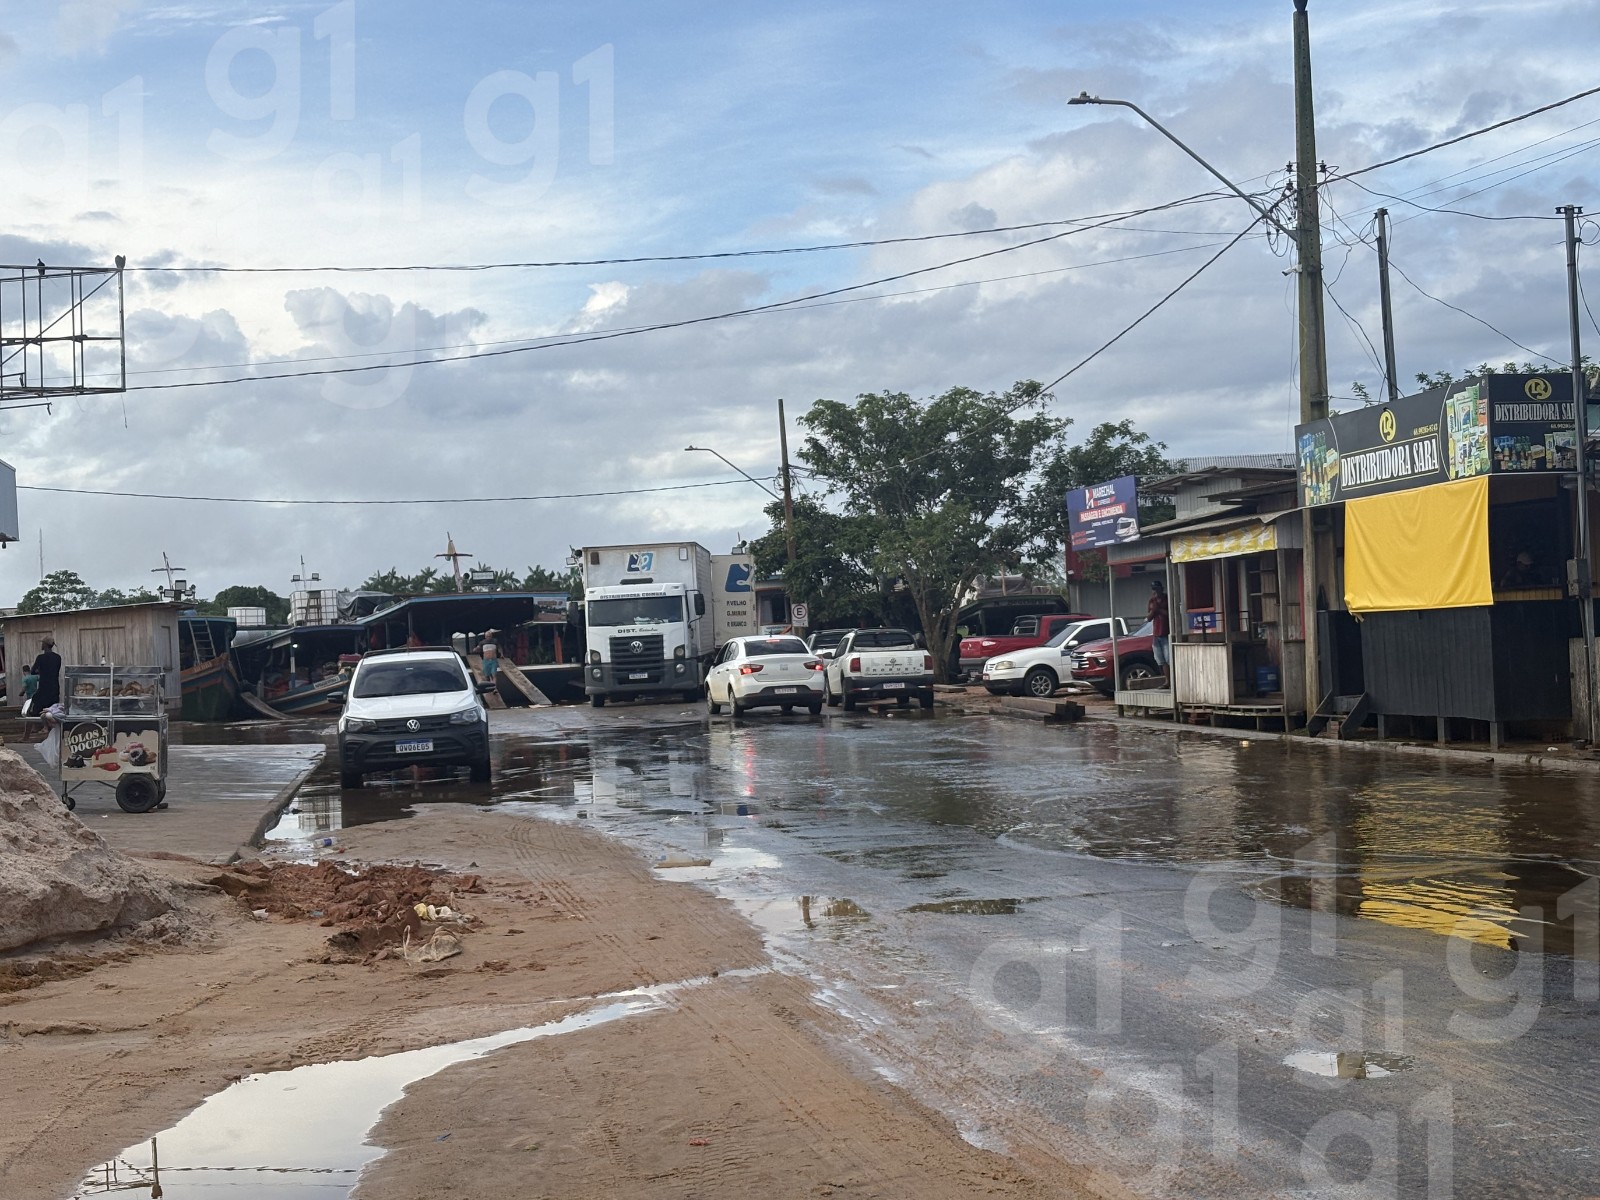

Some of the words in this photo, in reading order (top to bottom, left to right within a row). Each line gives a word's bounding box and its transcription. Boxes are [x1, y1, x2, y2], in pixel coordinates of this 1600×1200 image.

[1495, 403, 1560, 421] DISTRIBUIDORA
[1341, 444, 1412, 487] DISTRIBUIDORA
[1412, 438, 1439, 474] SARA
[70, 736, 106, 754] DOCES
